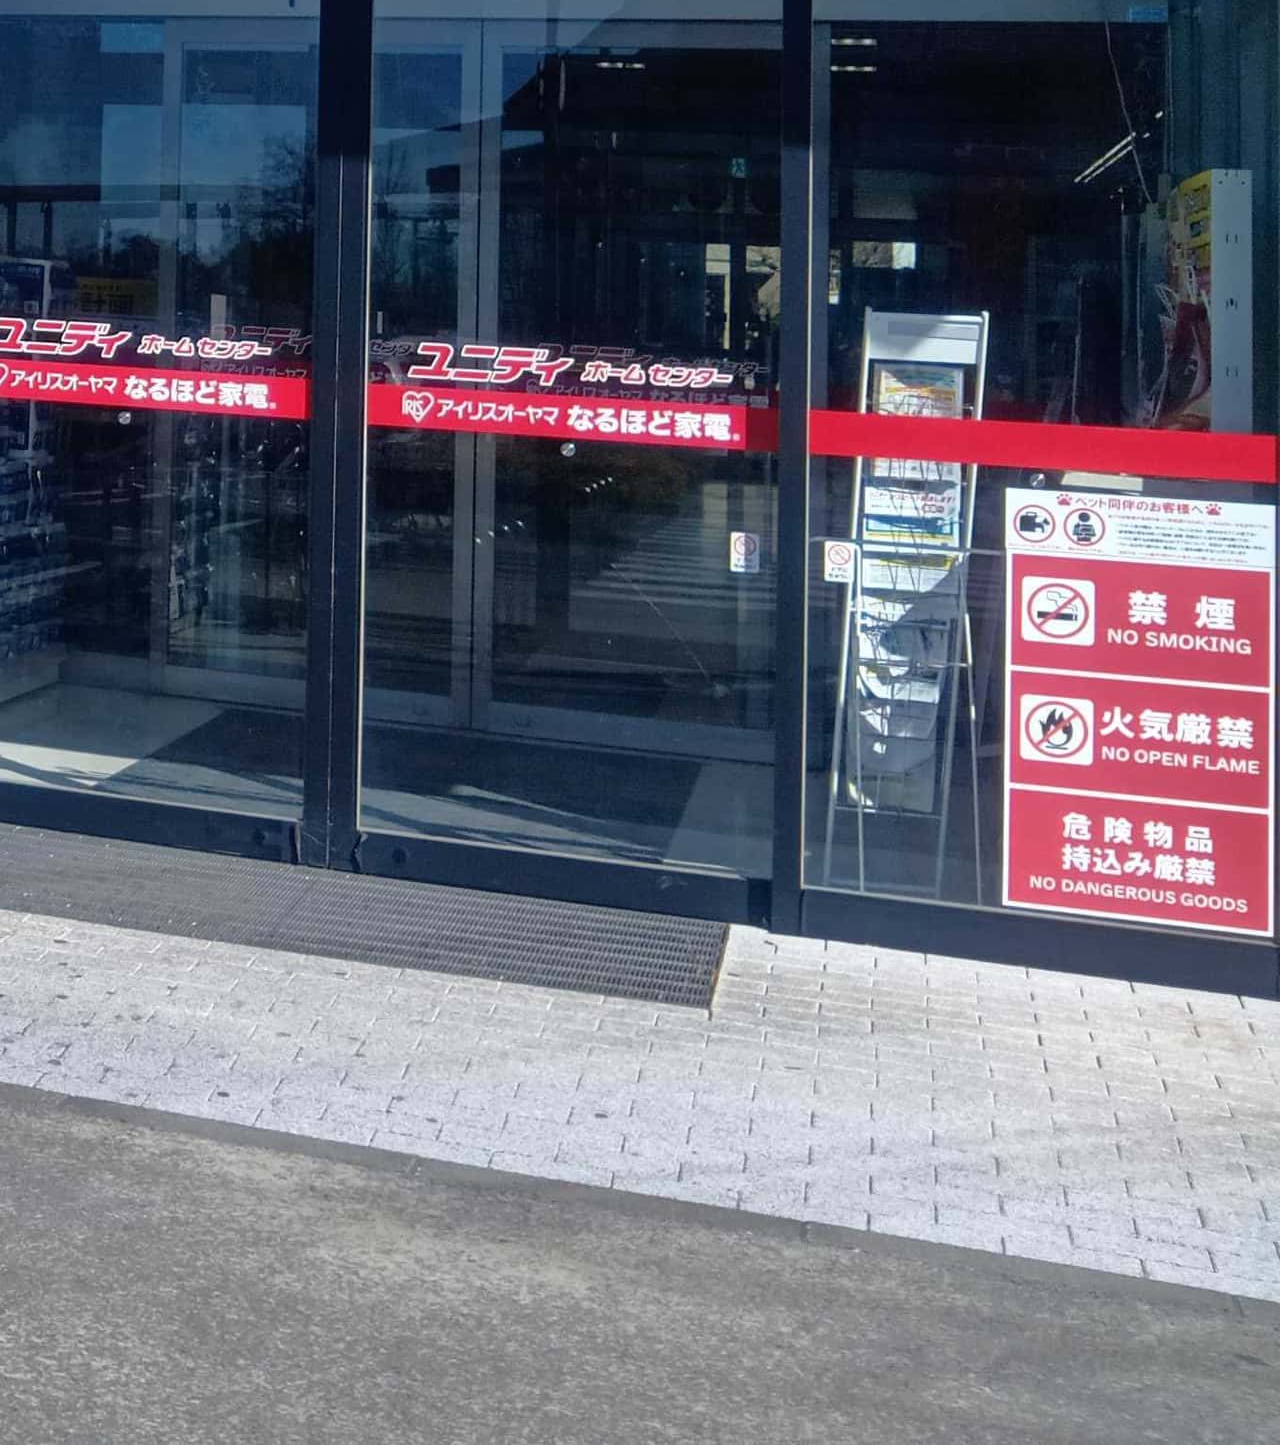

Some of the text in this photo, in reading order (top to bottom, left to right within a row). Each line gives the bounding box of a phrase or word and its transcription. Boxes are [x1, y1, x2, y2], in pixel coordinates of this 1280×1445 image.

[10, 369, 117, 394] アイリスオーヤマ
[408, 341, 575, 386] ユニディ
[437, 399, 559, 425] アイリスオーヤマ
[1128, 590, 1235, 631] 禁煙
[1107, 628, 1252, 655] NO SMOKING
[1099, 706, 1254, 750] 火気厳禁
[1101, 746, 1260, 775] NO OPEN FLAME
[1062, 812, 1213, 854] 危険物品
[1061, 844, 1216, 886] 持込み厳禁
[1029, 875, 1249, 913] NO DANGEROUS GOODS
